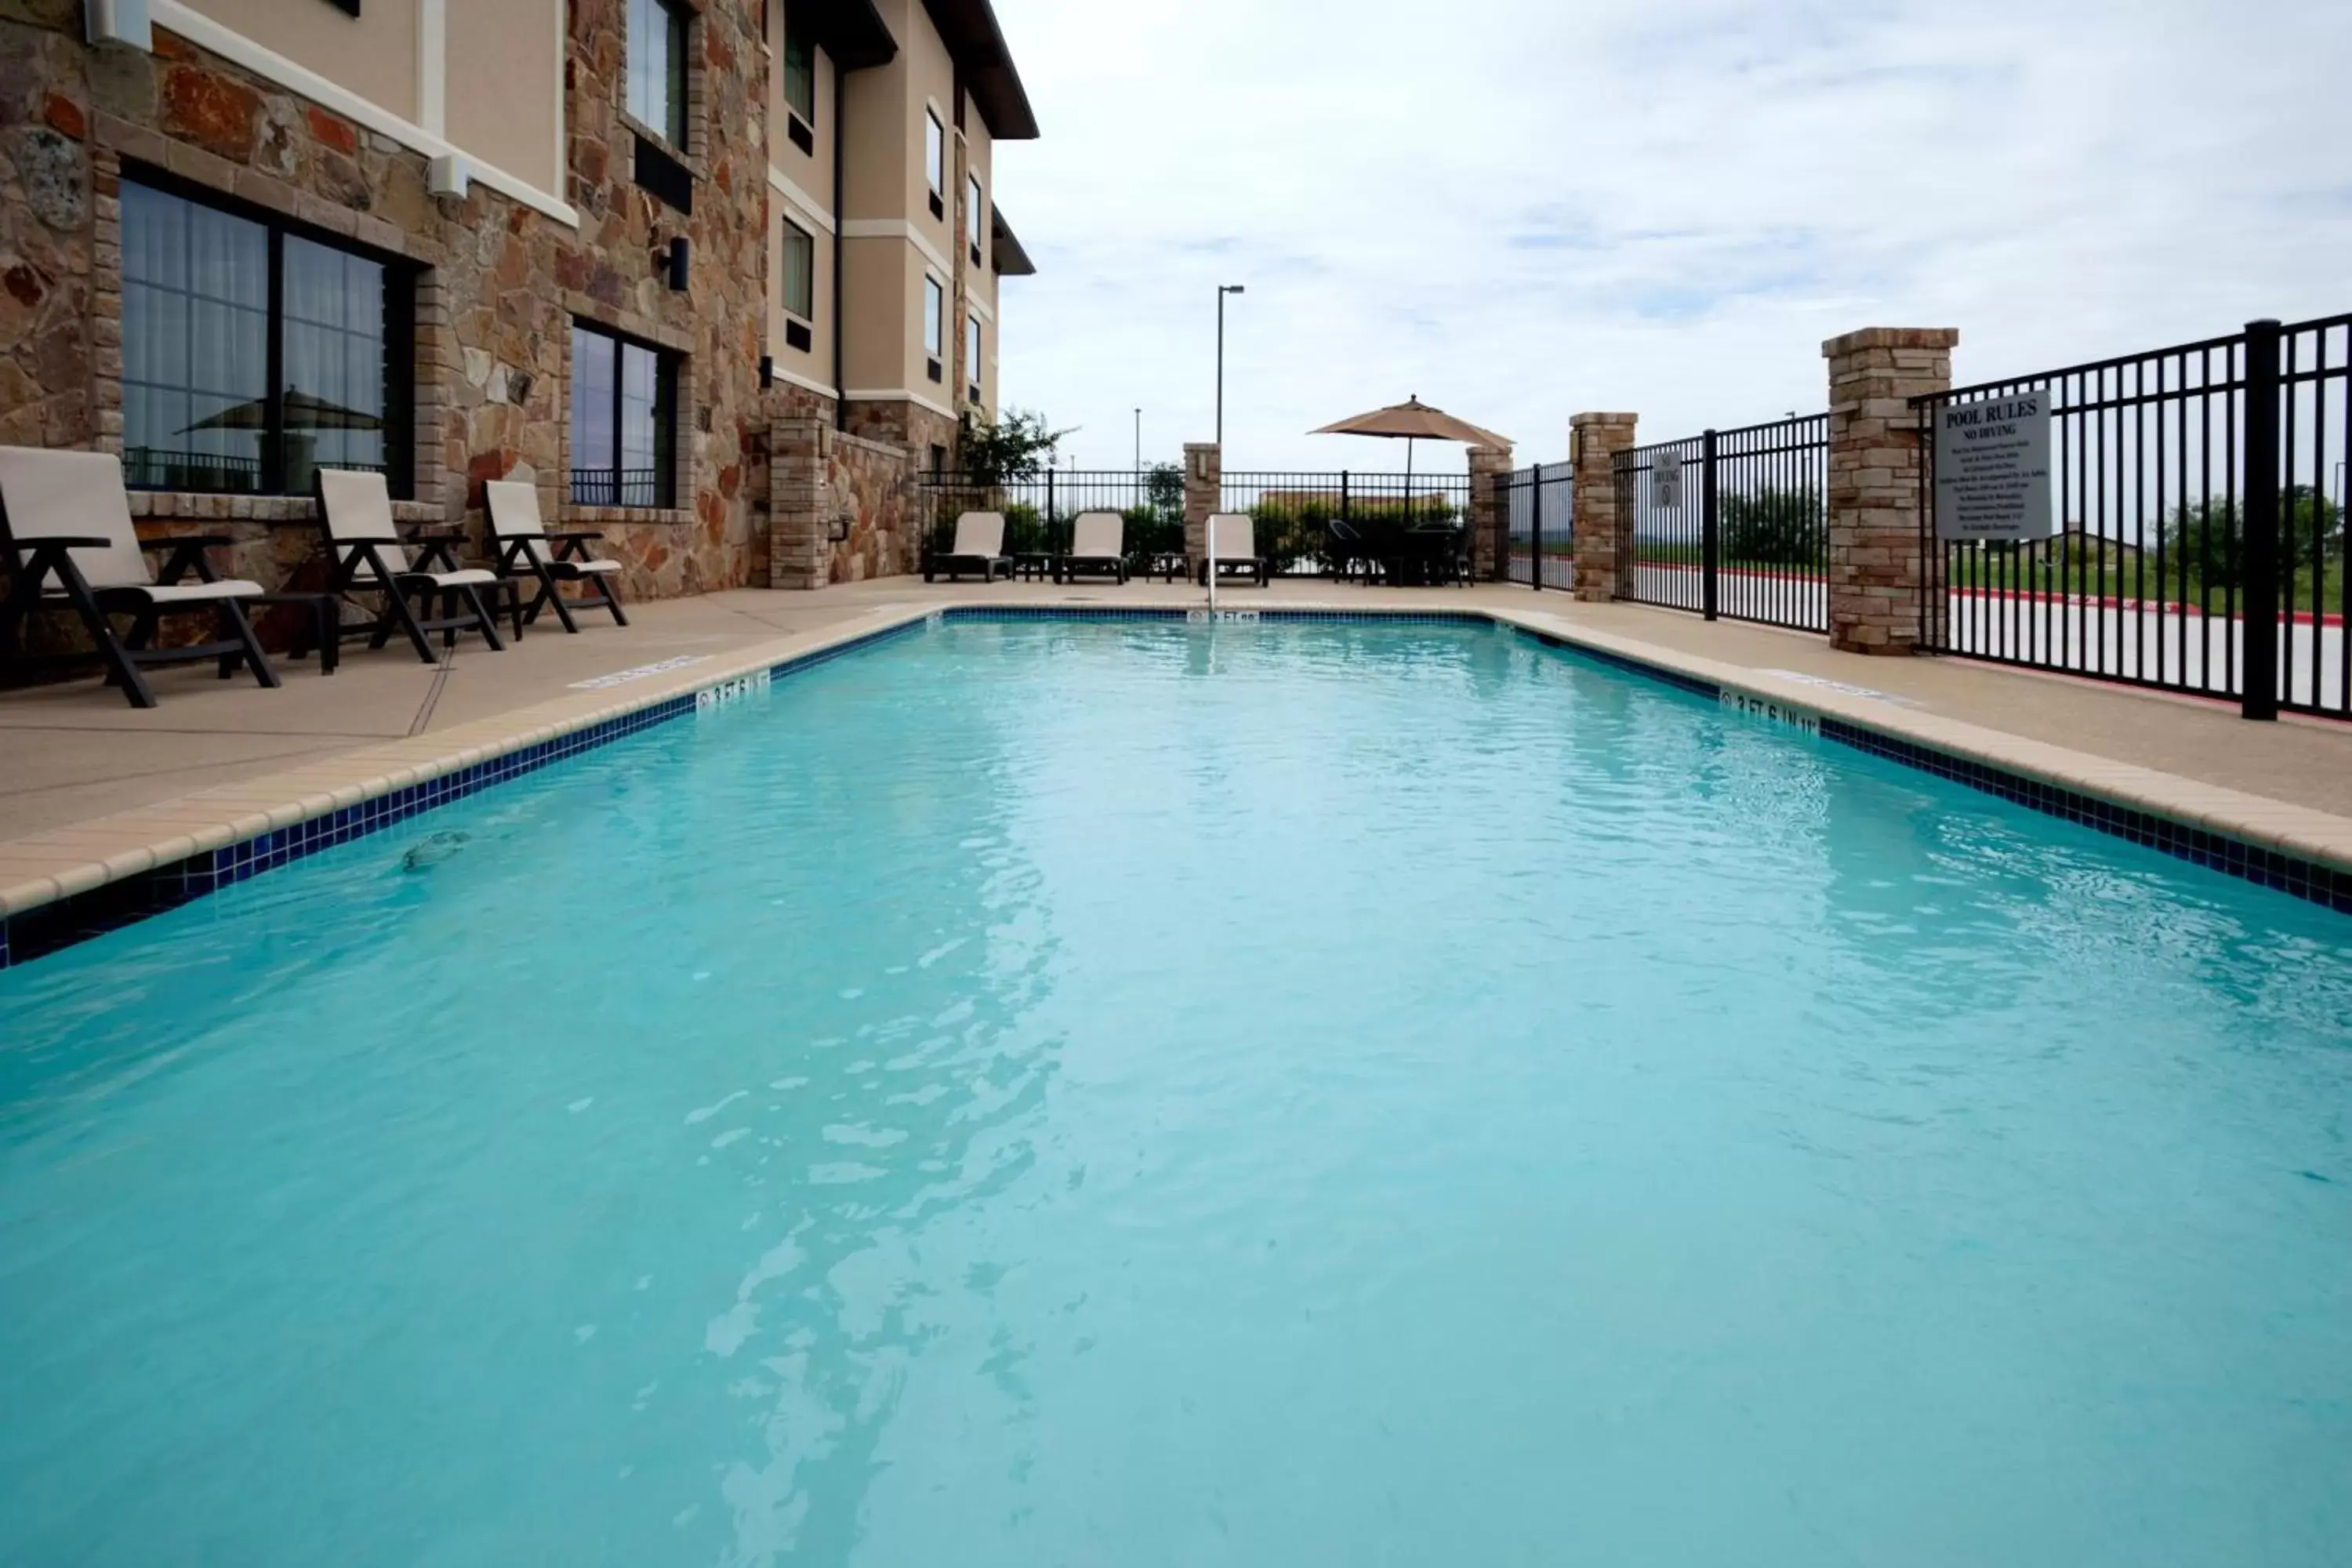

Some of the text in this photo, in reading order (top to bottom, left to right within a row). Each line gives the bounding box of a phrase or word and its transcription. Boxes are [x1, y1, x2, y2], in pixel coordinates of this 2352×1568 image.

[1947, 398, 2038, 429] POOL RULES
[1963, 424, 2016, 440] NO DIVING
